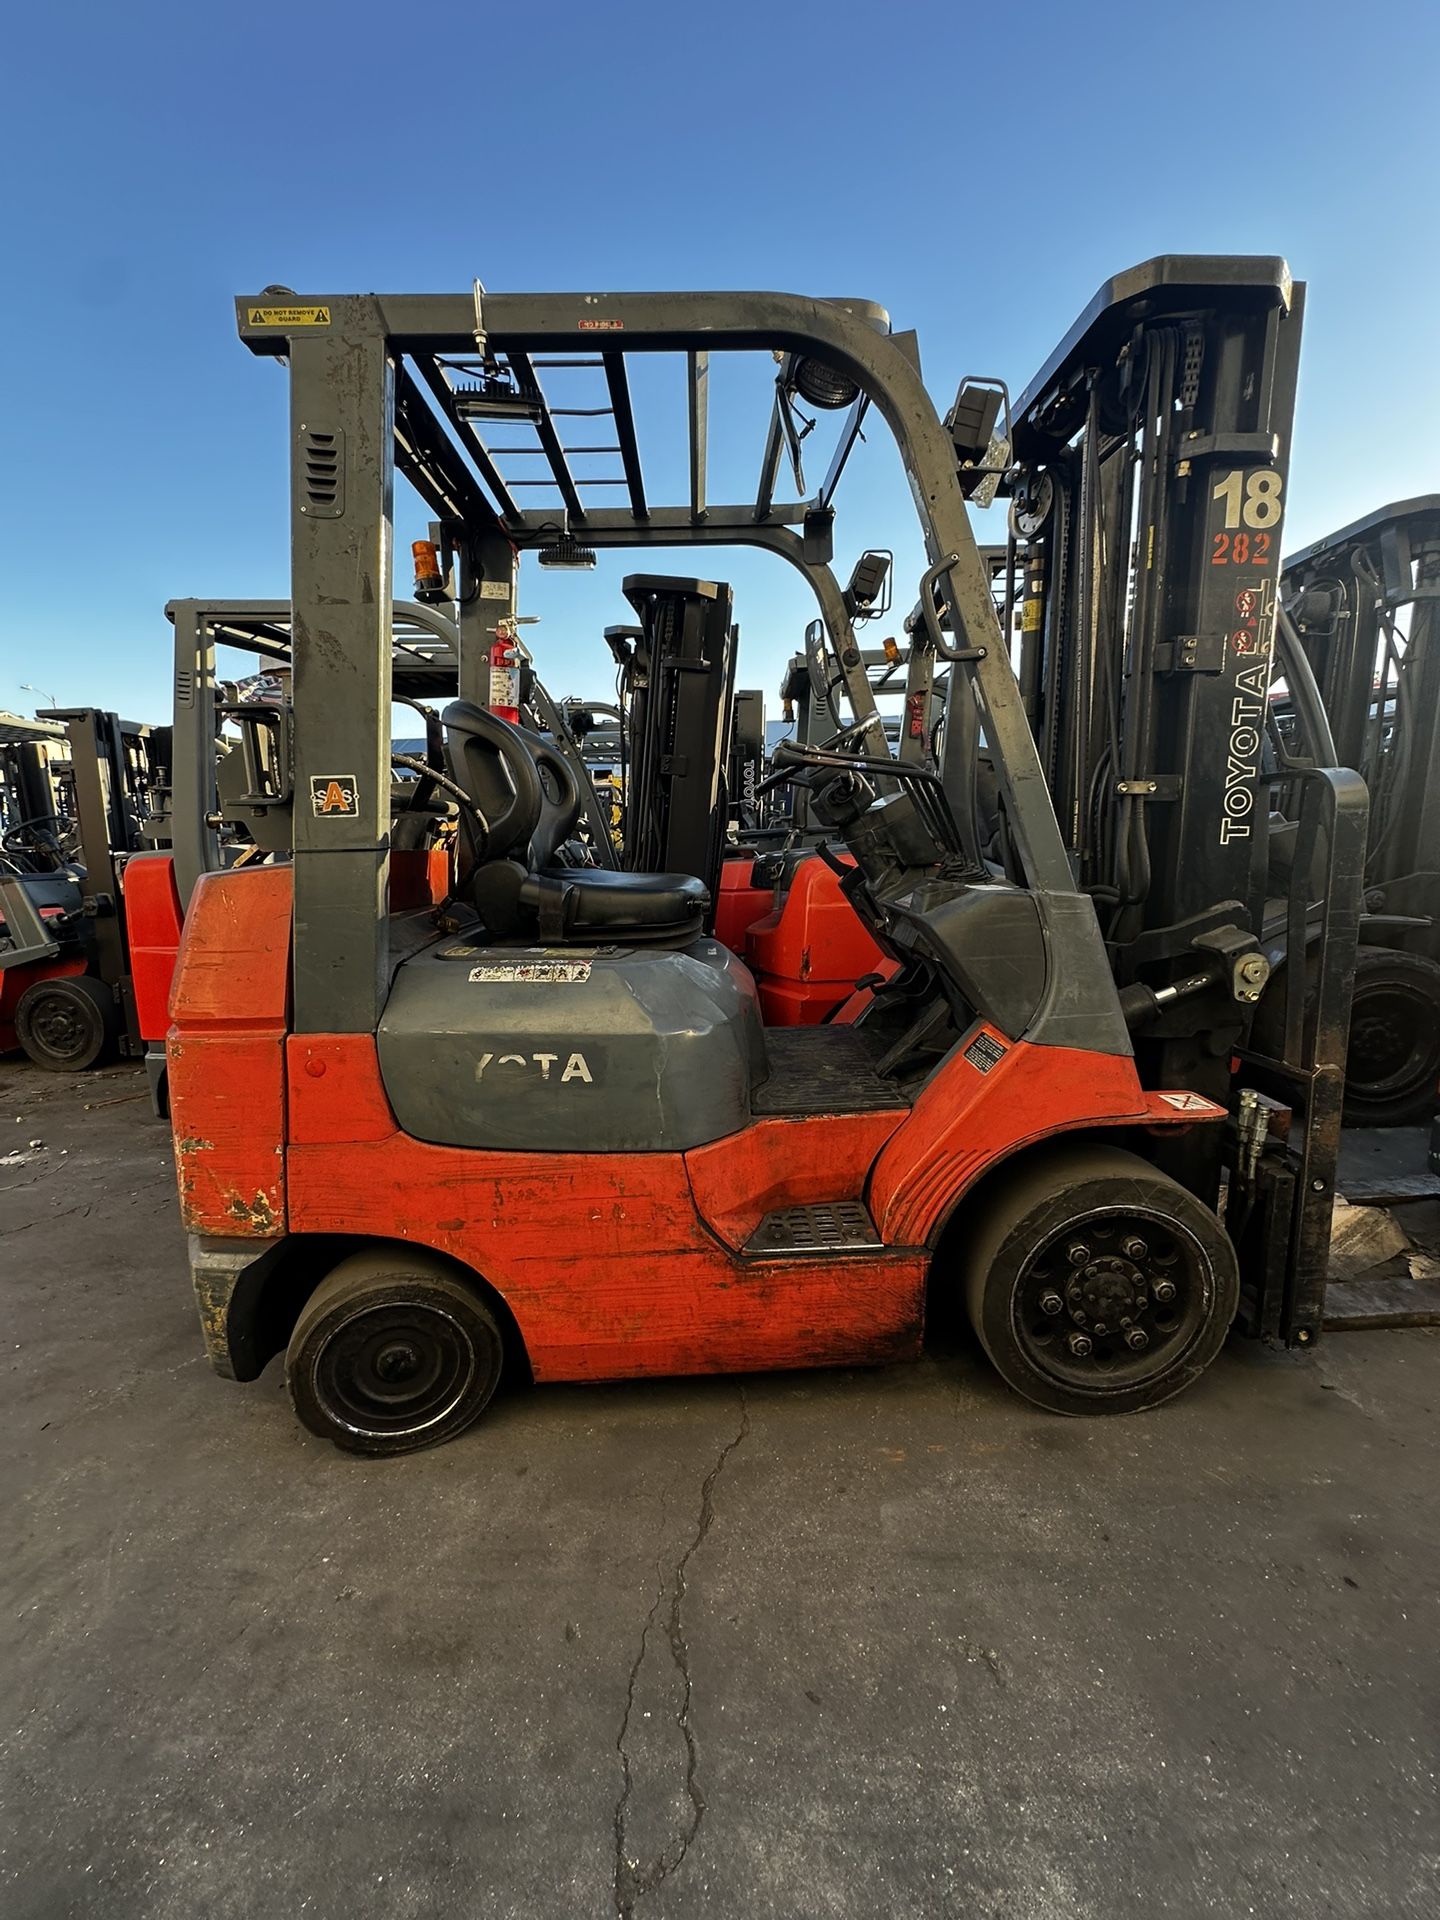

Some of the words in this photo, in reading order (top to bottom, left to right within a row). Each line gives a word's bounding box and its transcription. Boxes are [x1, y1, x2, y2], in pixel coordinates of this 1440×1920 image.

[1213, 470, 1282, 528] 18
[1211, 533, 1270, 565] 282
[1220, 663, 1267, 845] TOYOTA
